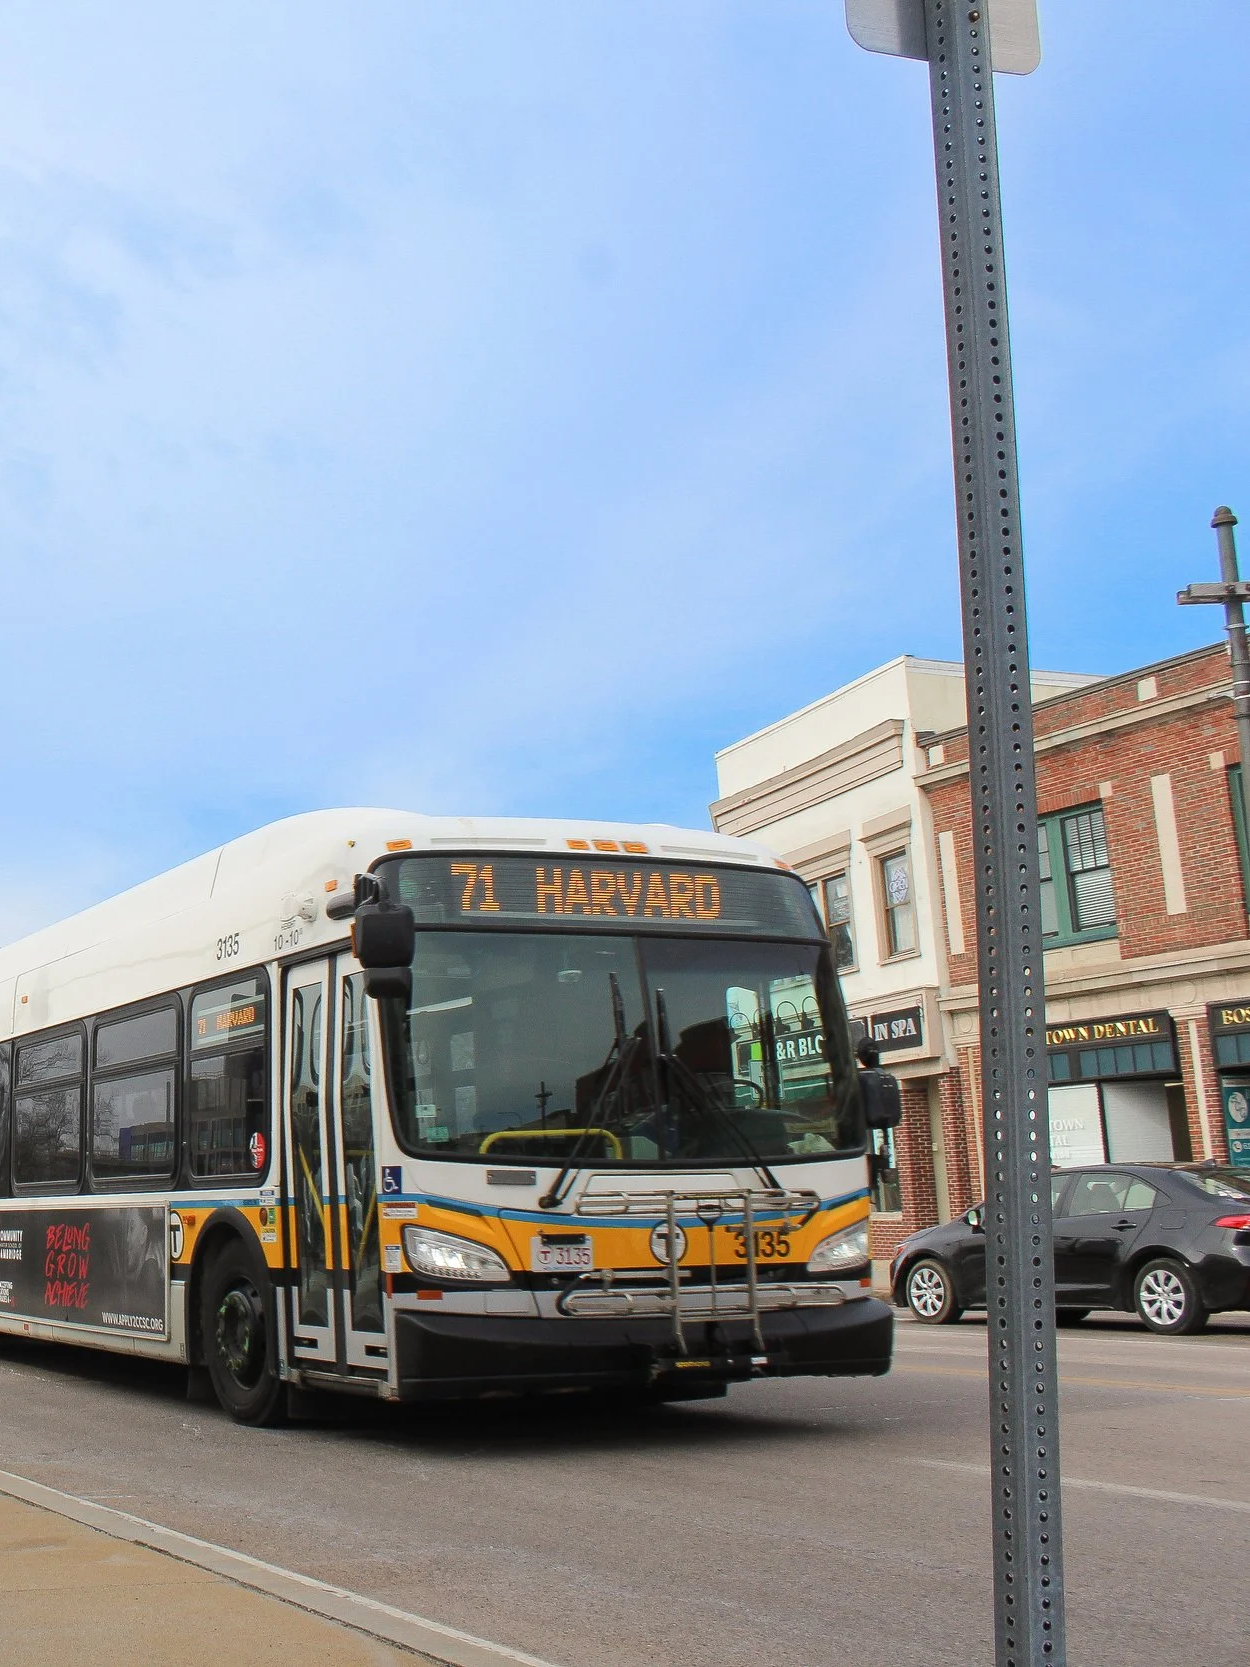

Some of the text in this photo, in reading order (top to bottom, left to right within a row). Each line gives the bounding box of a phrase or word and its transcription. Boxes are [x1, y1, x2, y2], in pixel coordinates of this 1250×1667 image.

[450, 863, 721, 919] 71 HARVARD
[216, 932, 240, 961] 3135
[197, 1006, 255, 1035] 71 HARVARD
[891, 1018, 917, 1039] SPA
[1093, 1017, 1159, 1039] DENTAL
[46, 1222, 90, 1252] BELONG
[734, 1231, 791, 1259] 3135
[45, 1250, 90, 1279] GROW
[555, 1247, 591, 1265] 3135
[45, 1280, 90, 1309] ACHIEVE
[101, 1311, 164, 1331] WWW.APPLY2CCSC.ORG
